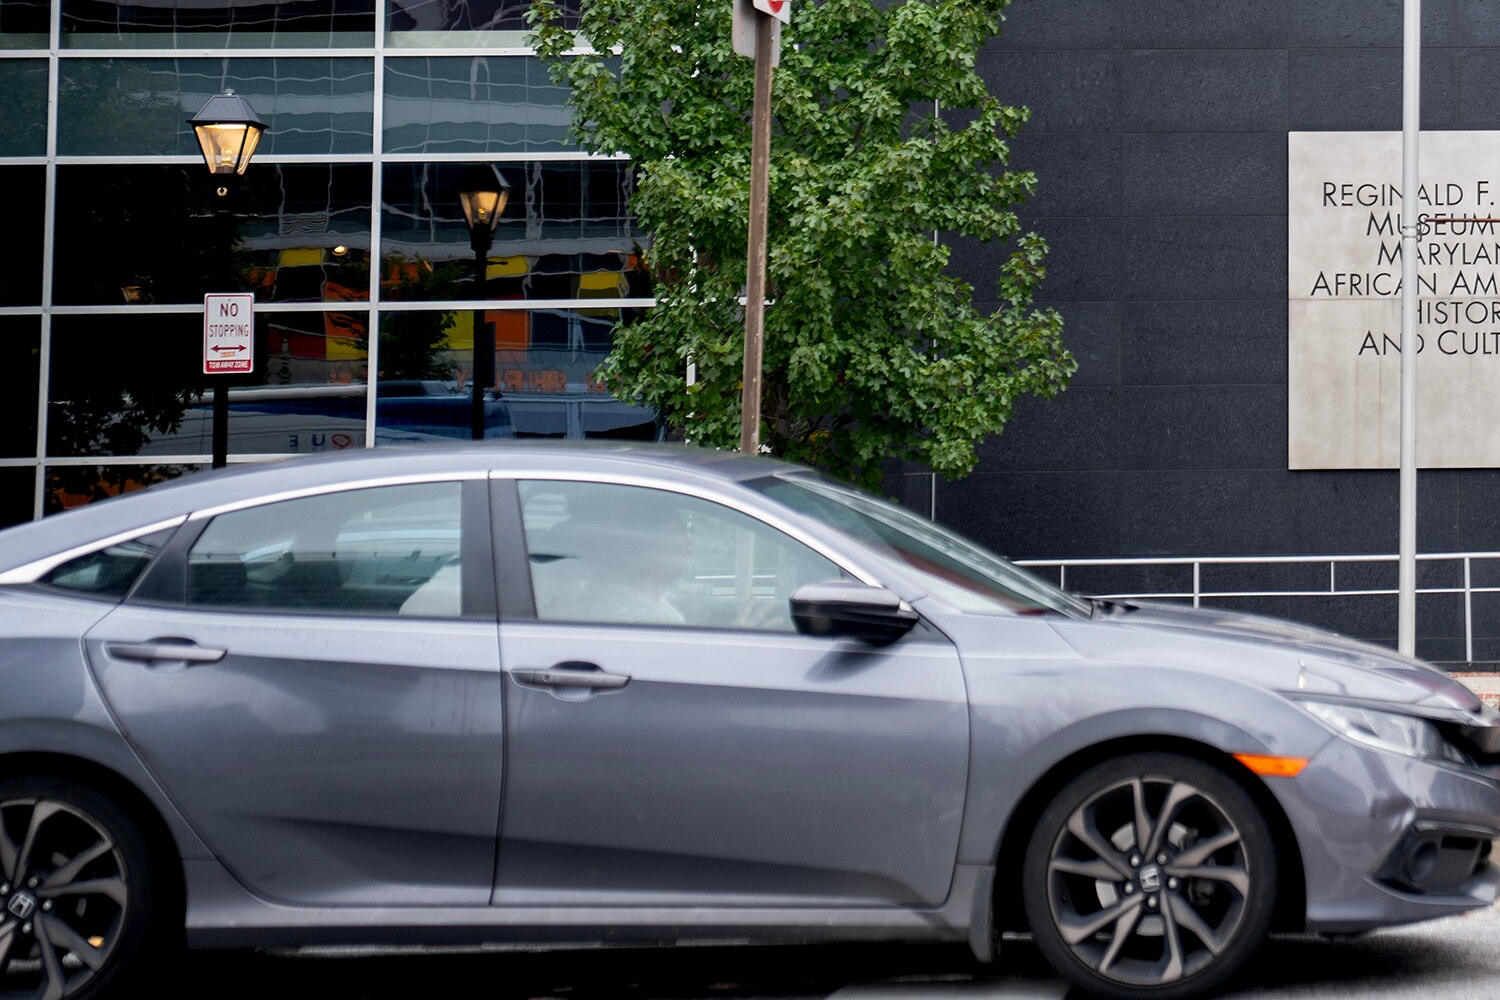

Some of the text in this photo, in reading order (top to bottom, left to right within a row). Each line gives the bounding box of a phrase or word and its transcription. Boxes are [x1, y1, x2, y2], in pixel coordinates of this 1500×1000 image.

[1322, 182, 1463, 207] REGINALD
[1477, 180, 1495, 206] F.
[220, 303, 239, 317] NO
[208, 324, 249, 338] STOPPING
